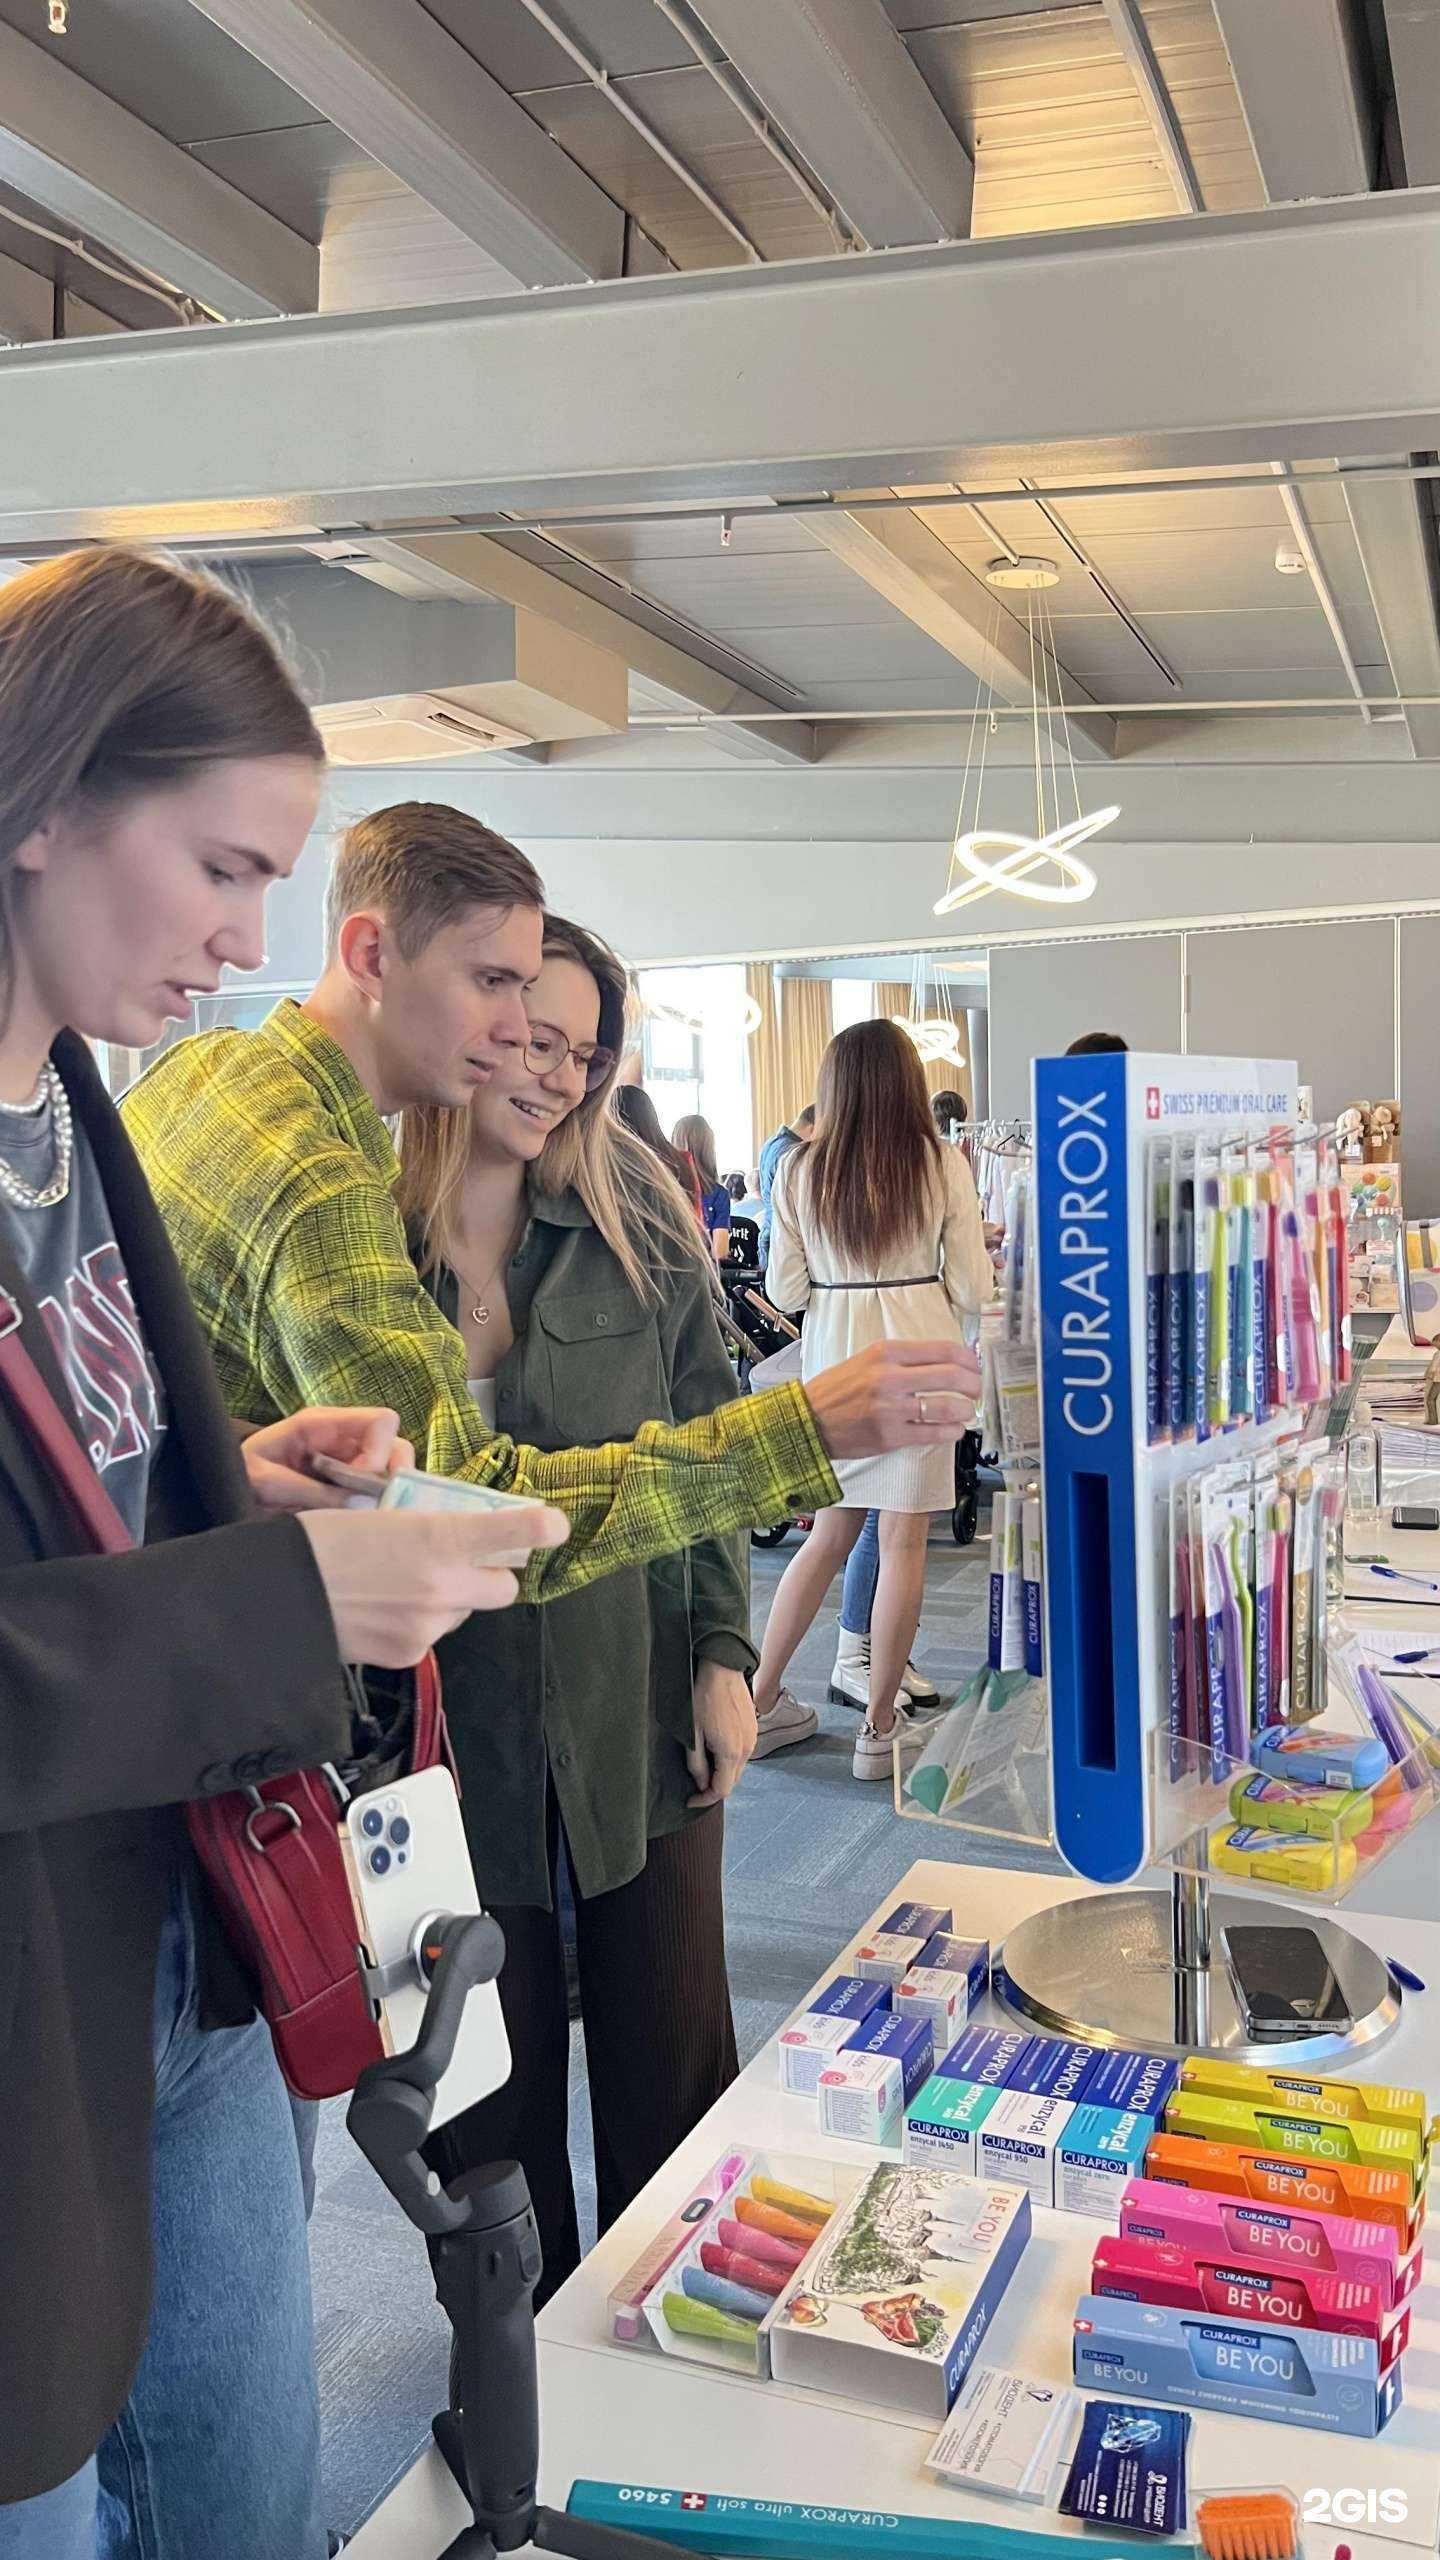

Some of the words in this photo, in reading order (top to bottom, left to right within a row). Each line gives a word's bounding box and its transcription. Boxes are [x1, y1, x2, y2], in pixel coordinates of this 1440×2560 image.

[1163, 1093, 1194, 1114] SWISS
[1197, 1093, 1240, 1114] PREMIUM
[1242, 1093, 1264, 1113] ORAL
[1266, 1093, 1288, 1113] CARE
[1057, 1091, 1113, 1435] CURAPROX
[1147, 1290, 1158, 1424] CURAPROX
[1171, 1289, 1182, 1424] CURAPROX
[1196, 1289, 1206, 1424] CURAPROX
[1253, 1277, 1264, 1404] CURAPROX
[991, 1577, 1001, 1637] CURAPROX
[1028, 1583, 1038, 1644] CURAPROX
[1296, 1588, 1309, 1708] CURAPROX
[1257, 1601, 1269, 1730] CURAPROX
[827, 1980, 864, 2014] CURAPROX
[865, 2014, 902, 2051] CURAPROX
[977, 2033, 1023, 2084] CURAPROX
[1050, 2046, 1093, 2098] CURAPROX
[1127, 2058, 1166, 2112] CURAPROX
[1275, 2080, 1320, 2094] CURAPROX
[951, 2084, 985, 2122] enzycal
[1027, 2099, 1058, 2137] enzycal
[1286, 2092, 1306, 2108] BE
[1310, 2096, 1349, 2118] YOU
[910, 2120, 968, 2143] CURAPROX
[910, 2135, 937, 2148] enzycal
[938, 2140, 954, 2150] 1450
[1107, 2113, 1138, 2153] enzycal
[1272, 2120, 1319, 2134] CURAPROX
[983, 2135, 1044, 2157] CURAPROX
[984, 2149, 1012, 2163] enzycal
[1014, 2154, 1028, 2164] 950
[1283, 2132, 1304, 2150] BE
[1307, 2136, 1349, 2159] YOU
[1063, 2152, 1125, 2174] CURAPROX
[1255, 2161, 1305, 2177] CURAPROX
[1267, 2174, 1289, 2193] BE
[1292, 2180, 1335, 2205] YOU
[1238, 2209, 1289, 2228] CURAPROX
[1250, 2225, 1272, 2246] BE
[1275, 2230, 1320, 2257] YOU
[1215, 2270, 1269, 2289] CURAPROX
[1227, 2286, 1253, 2309] BE
[1256, 2292, 1303, 2321] YOU
[950, 2303, 987, 2391] CURAPROX
[1202, 2329, 1258, 2347] CURAPROX
[1084, 2350, 1123, 2365] CURAPROX
[1093, 2363, 1112, 2379] BE
[1113, 2367, 1148, 2384] YOU
[1216, 2345, 1241, 2370] BE
[1245, 2351, 1294, 2380] YOU
[998, 2378, 1023, 2419] БИОДЕНТ
[618, 2488, 672, 2505] 5460
[717, 2498, 748, 2513] soft
[755, 2501, 793, 2518] ultra
[1153, 2486, 1167, 2527] БИОДЕНТ
[799, 2506, 898, 2529] CURAPROX
